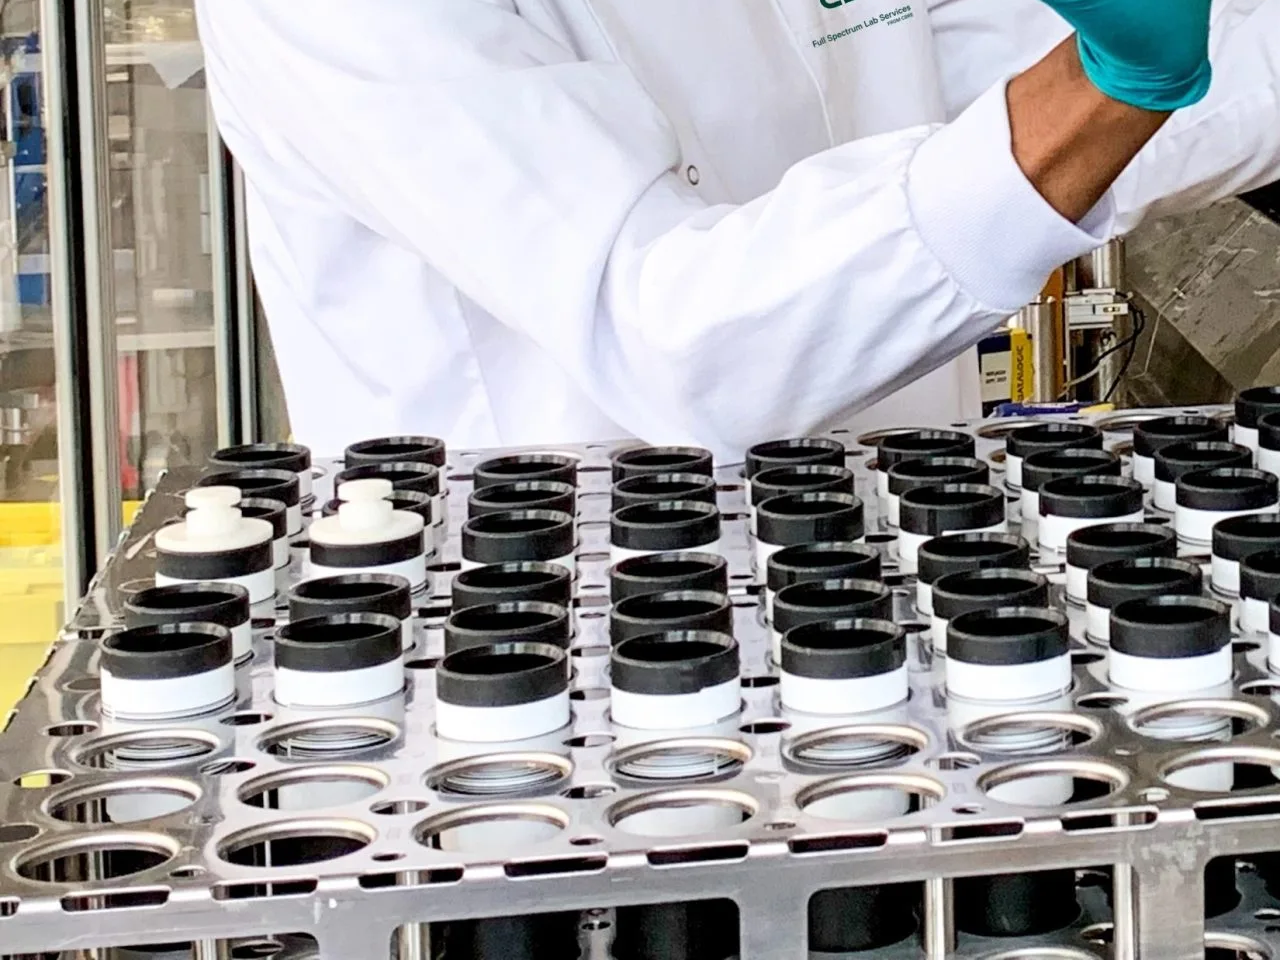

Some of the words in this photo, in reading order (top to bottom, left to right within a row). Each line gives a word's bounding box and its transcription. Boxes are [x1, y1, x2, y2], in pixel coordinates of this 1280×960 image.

[812, 35, 827, 48] Full
[827, 23, 864, 42] Spectrum
[863, 17, 879, 28] Lab
[879, 4, 912, 22] Services
[887, 17, 902, 27] FROM
[901, 12, 914, 21] CBRE
